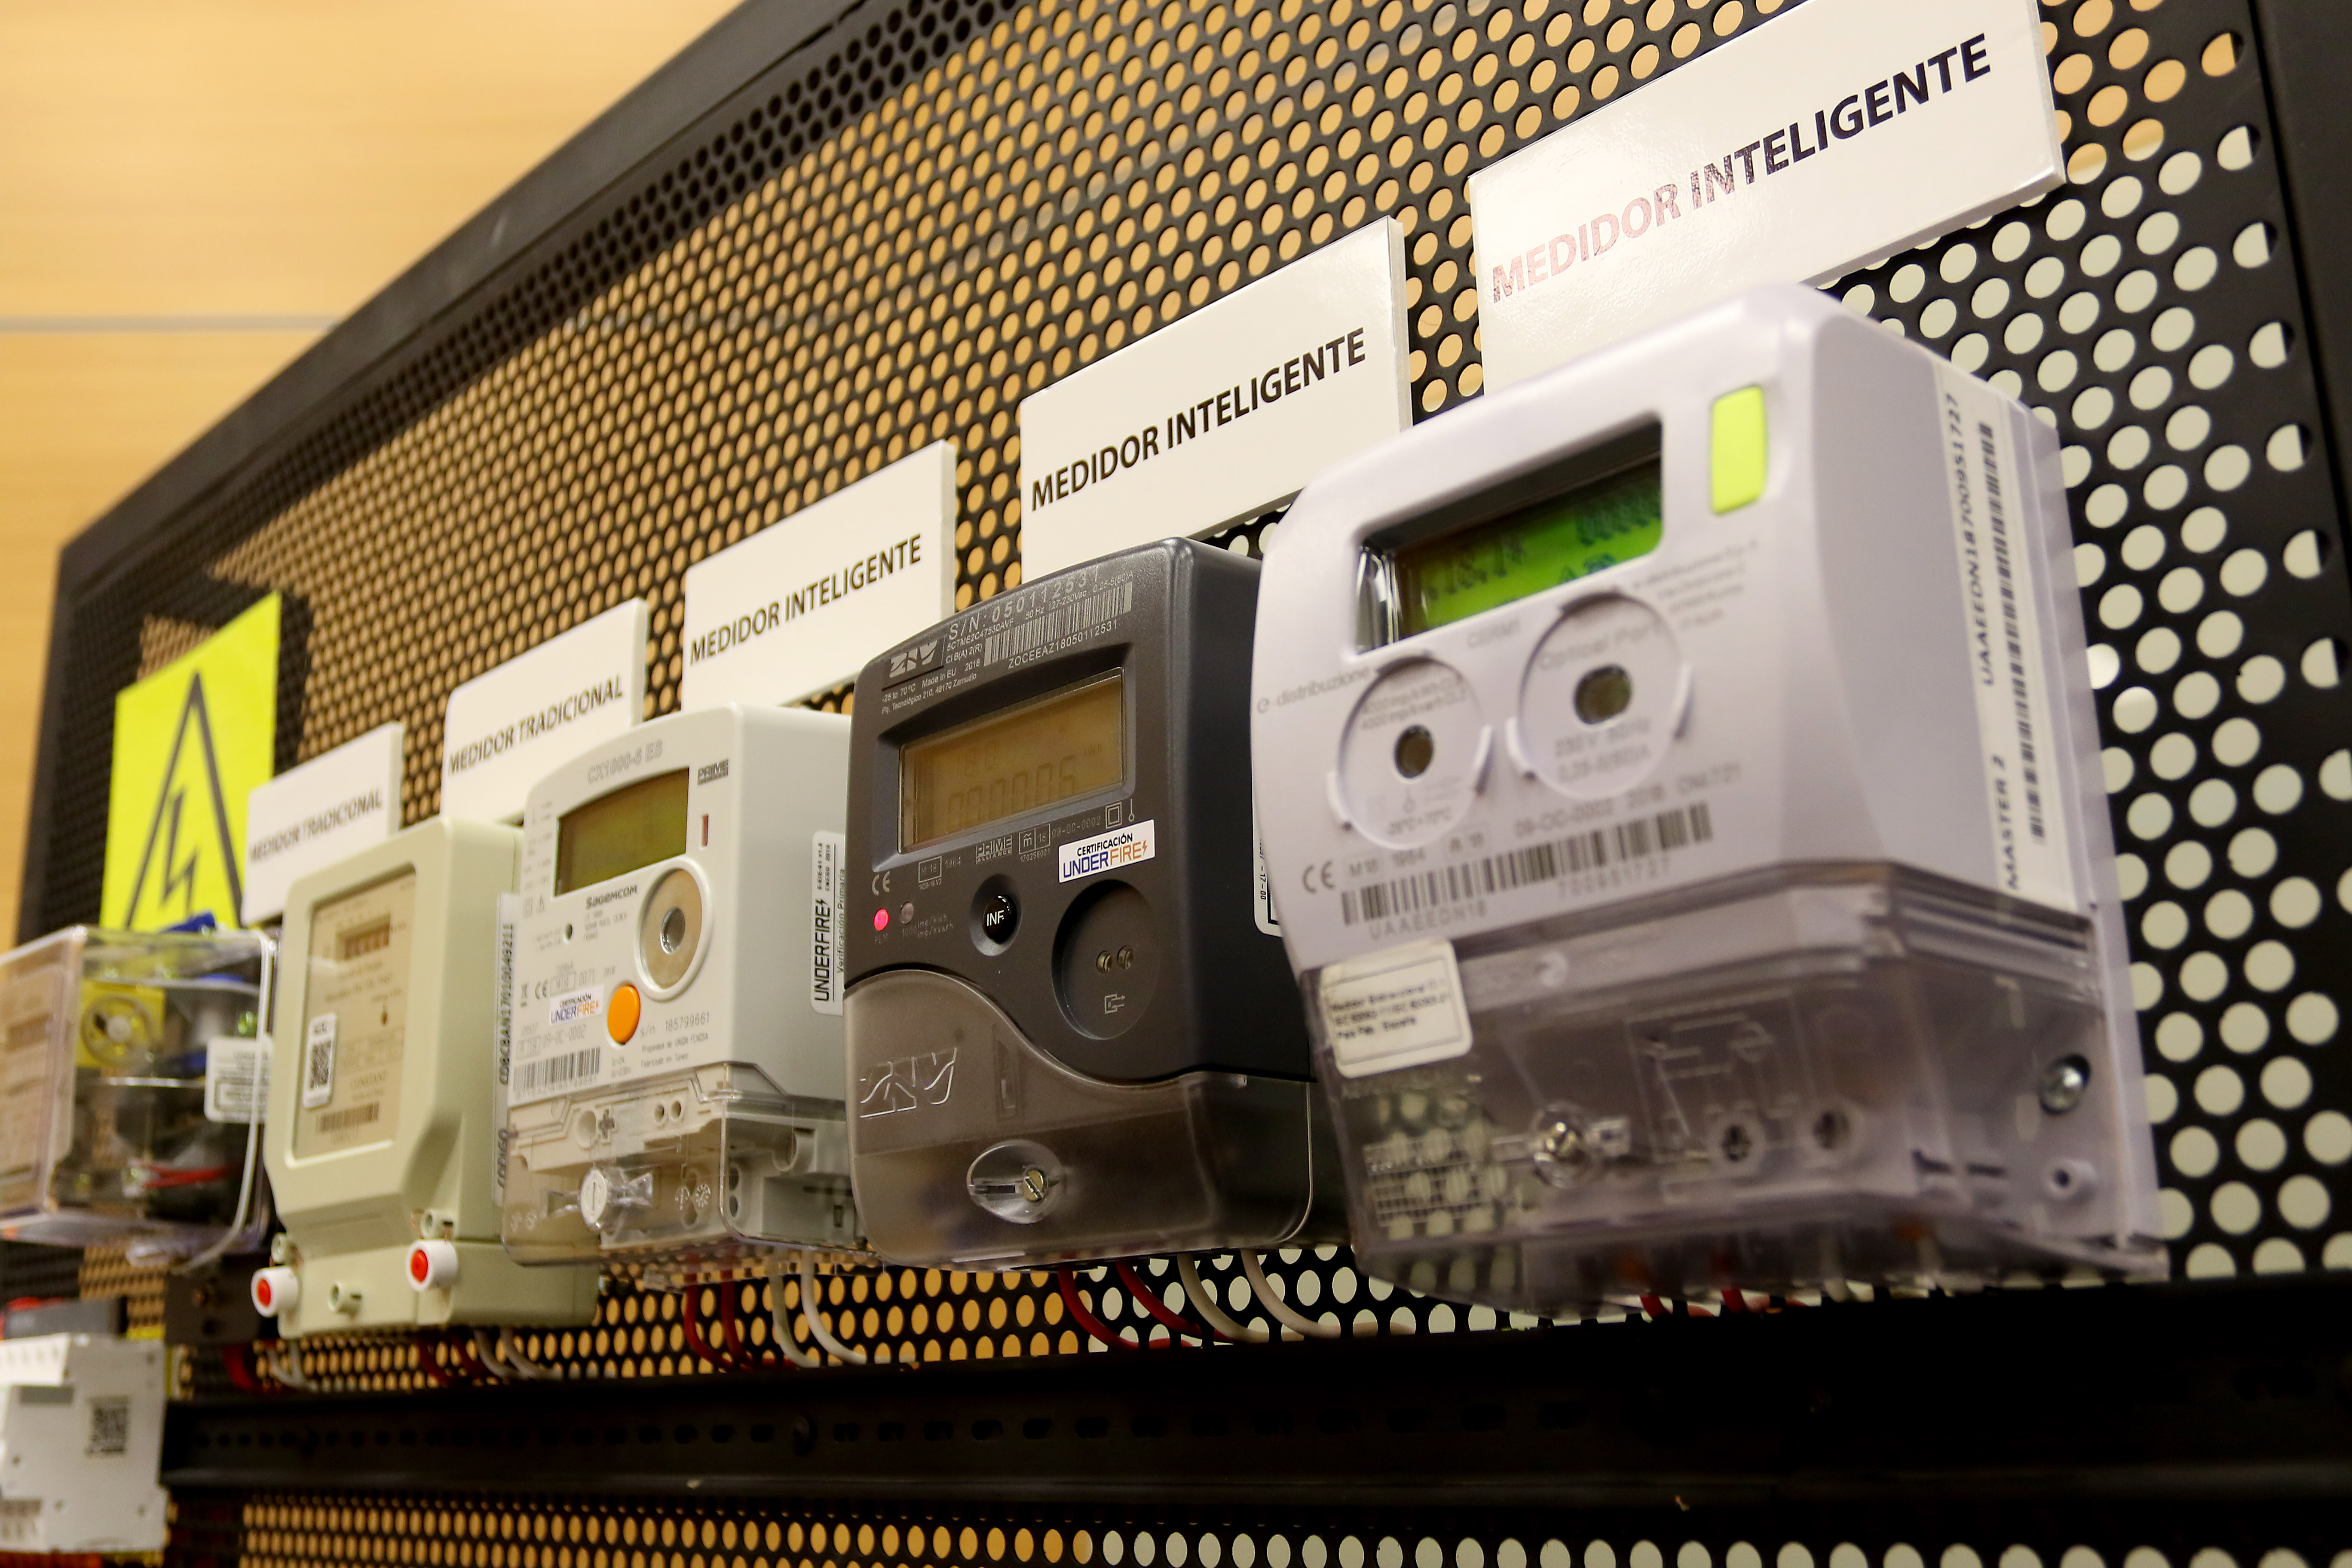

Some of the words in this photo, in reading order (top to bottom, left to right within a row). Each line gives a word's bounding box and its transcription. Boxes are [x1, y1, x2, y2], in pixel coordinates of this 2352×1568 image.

[1492, 182, 1681, 302] MEDIDOR
[1691, 33, 1991, 210] INTELIGENTE
[1031, 425, 1159, 511] MEDIDOR
[1167, 327, 1366, 450] INTELIGENTE
[690, 602, 779, 665] MEDIDOR
[785, 534, 920, 622] INTELIGENTE
[922, 678, 938, 688] Made
[947, 668, 956, 679] EU
[965, 659, 980, 671] 2018
[953, 673, 977, 686] Zamudio
[448, 724, 514, 776] MEDIDOR
[518, 674, 623, 742] TRADICIONAL
[977, 850, 1011, 863] ALLIANCE
[1063, 841, 1142, 878] UNDERFIRE
[1077, 833, 1133, 857] CERTIFICACIÓN
[1996, 779, 2019, 889] MASTER
[814, 905, 830, 1001] UNDERFIRE
